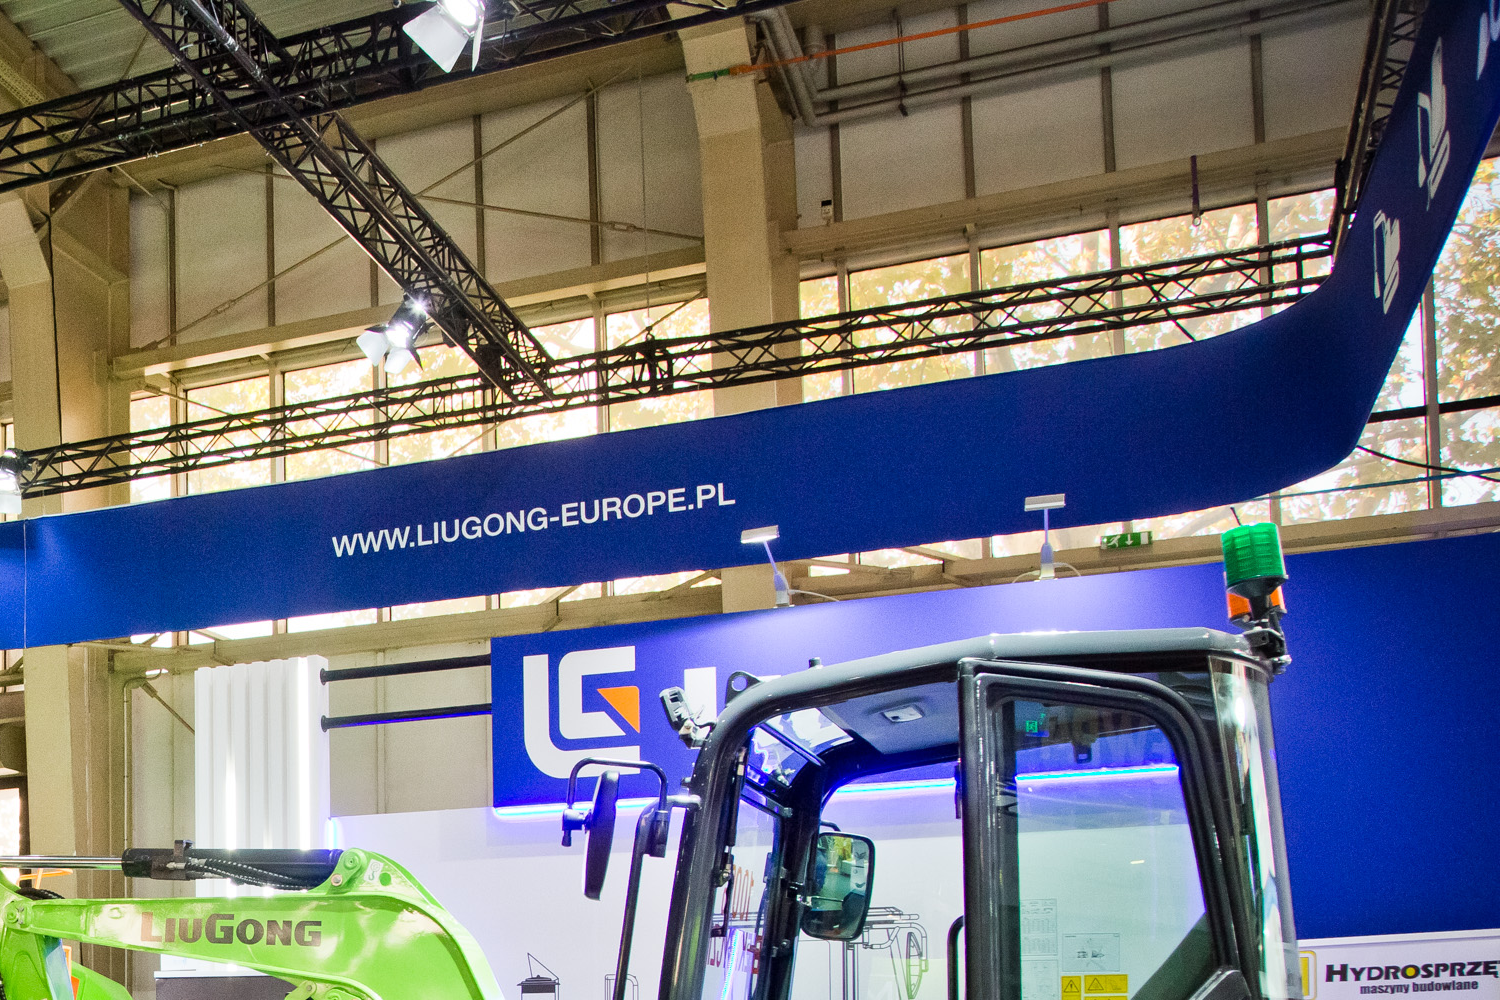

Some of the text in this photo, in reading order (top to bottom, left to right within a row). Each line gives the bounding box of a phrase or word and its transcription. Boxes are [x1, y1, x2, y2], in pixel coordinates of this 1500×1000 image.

[332, 482, 736, 558] WWW.LIUGONG-EUROPE.PL
[1325, 960, 1500, 983] HYDROSPRZĘ
[1360, 980, 1479, 995] maszyny budowlane
